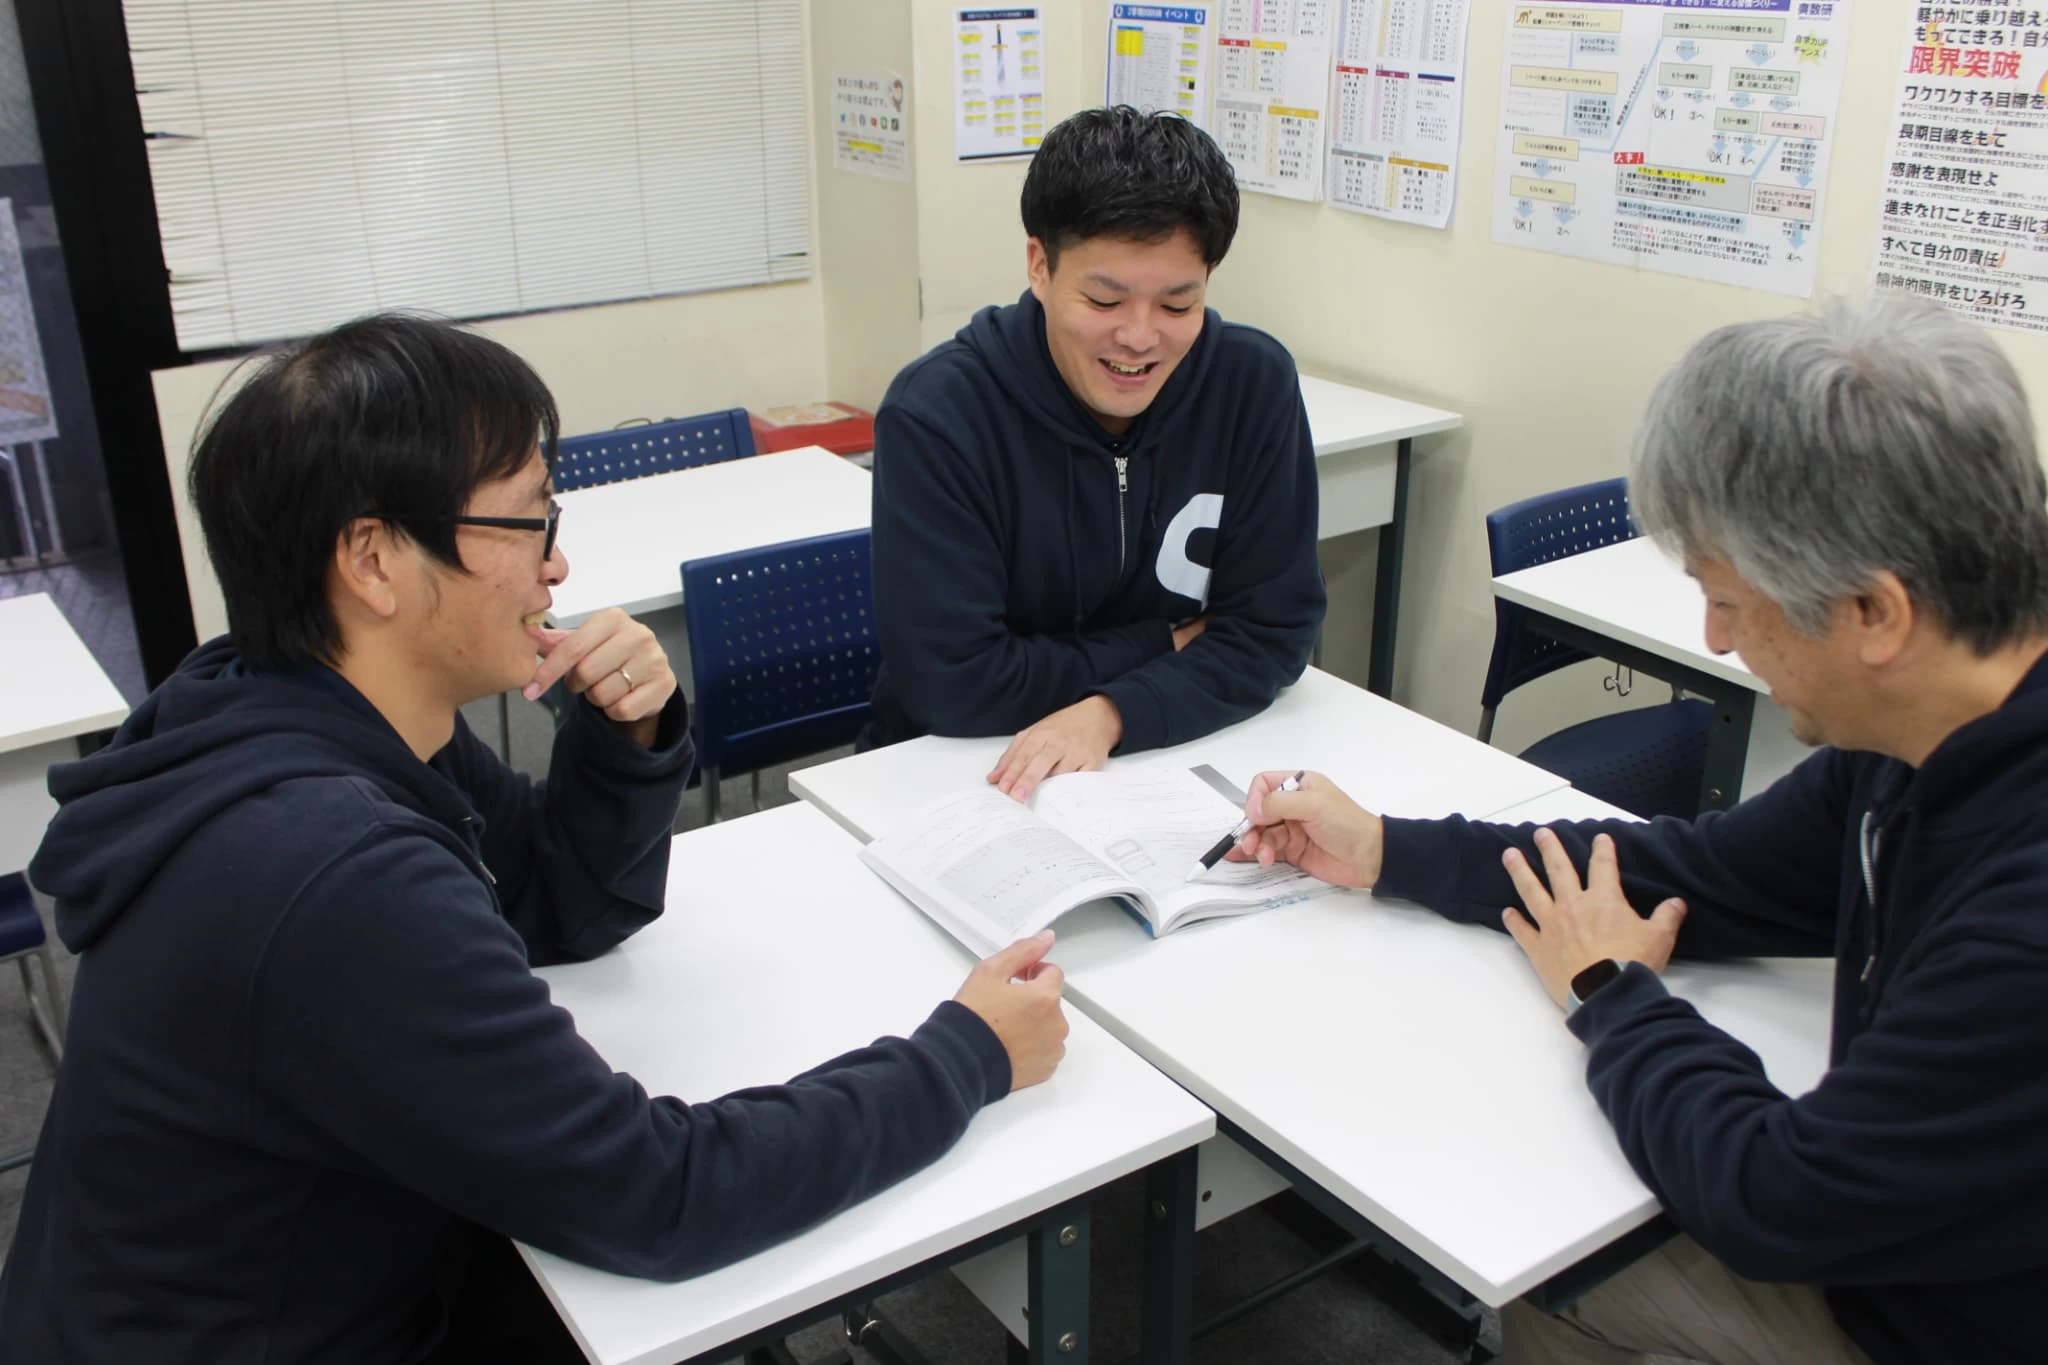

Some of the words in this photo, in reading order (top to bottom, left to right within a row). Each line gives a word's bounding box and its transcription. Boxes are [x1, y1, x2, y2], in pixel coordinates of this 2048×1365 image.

[1917, 7, 2048, 27] 軽やかに乗り越え
[1909, 46, 2022, 80] 限界突破
[1898, 123, 2007, 148] 長期目線をもて
[1890, 162, 1999, 187] 感謝を表現せよ
[1881, 236, 2000, 268] すべて自分の責任
